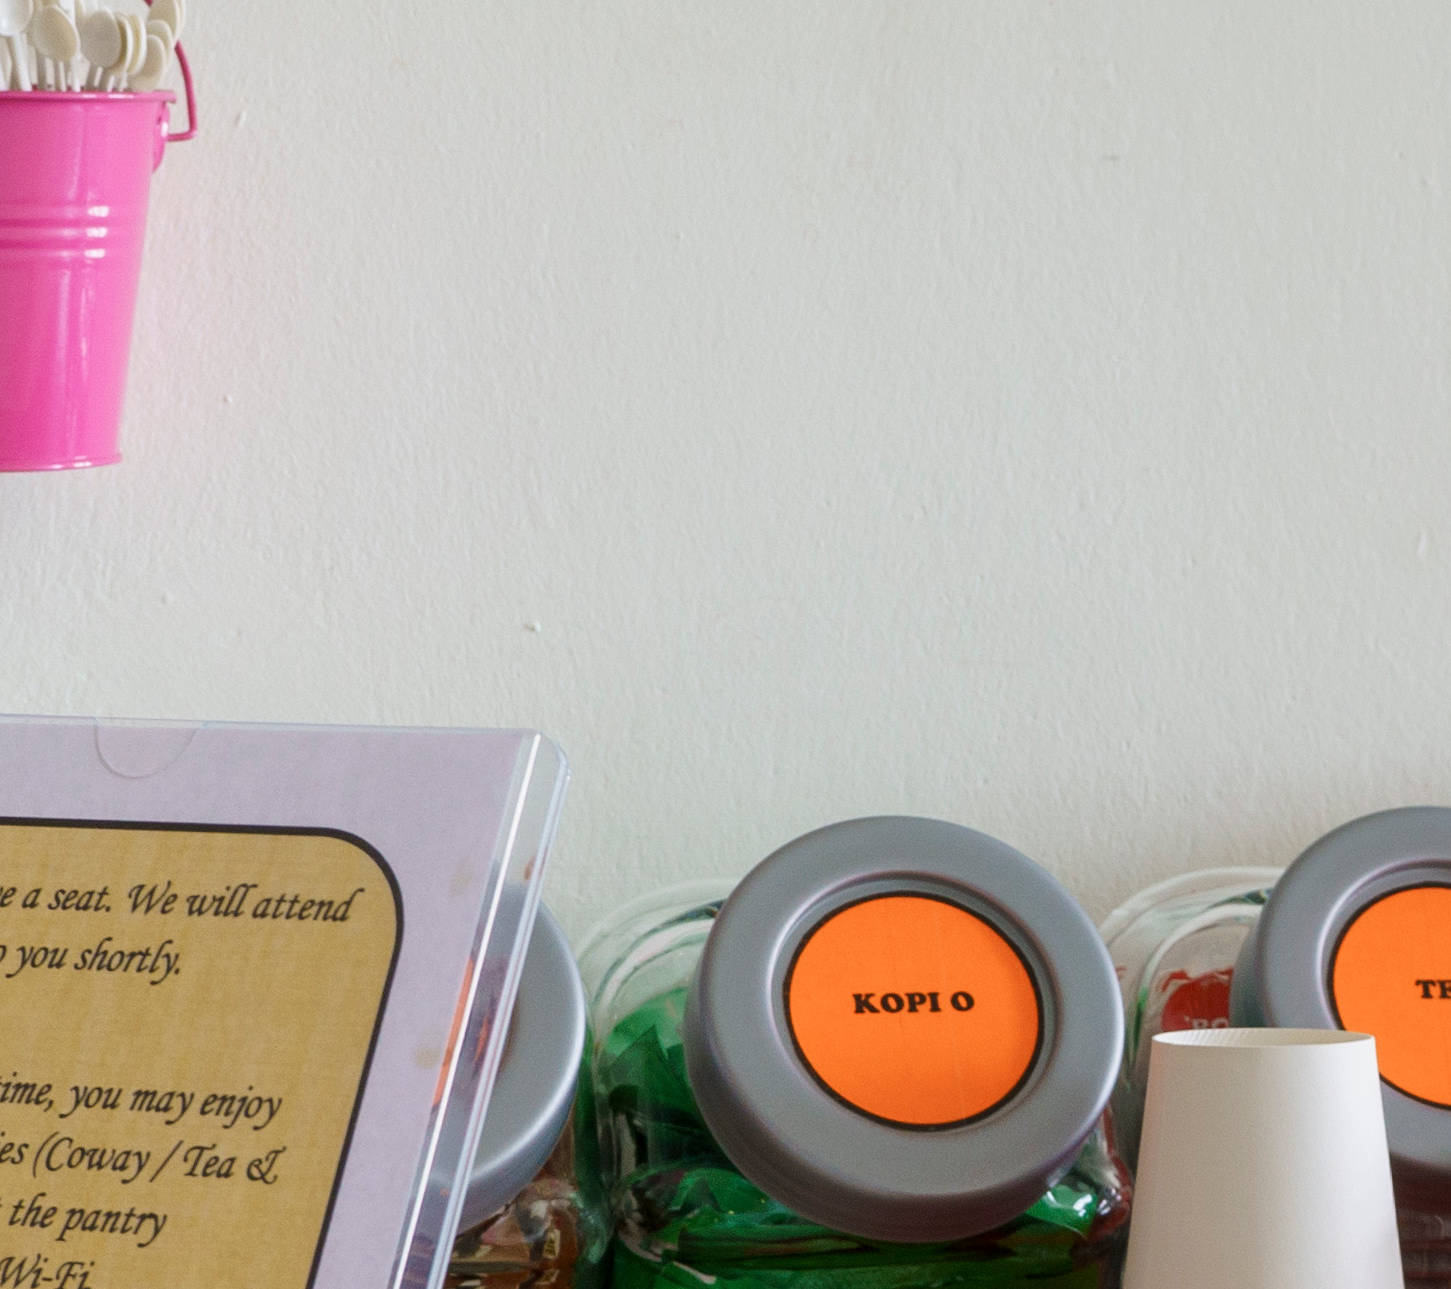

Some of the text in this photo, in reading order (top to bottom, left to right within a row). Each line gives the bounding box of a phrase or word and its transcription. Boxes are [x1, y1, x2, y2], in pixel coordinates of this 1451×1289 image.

[21, 887, 42, 909] a
[47, 886, 111, 913] seat.
[127, 880, 179, 915] We
[186, 882, 259, 918] will
[251, 887, 365, 923] attend
[5, 945, 69, 979] you
[73, 936, 180, 986] shortly.
[851, 990, 976, 1015] KOPI O
[58, 1085, 123, 1119] you
[129, 1089, 195, 1126] may
[199, 1085, 283, 1131] enjoy
[32, 1132, 151, 1185] (Coway
[149, 1140, 184, 1183] /
[182, 1143, 237, 1179] Tea
[245, 1146, 287, 1185] &
[8, 1191, 58, 1229] the
[55, 1207, 168, 1249] pantry
